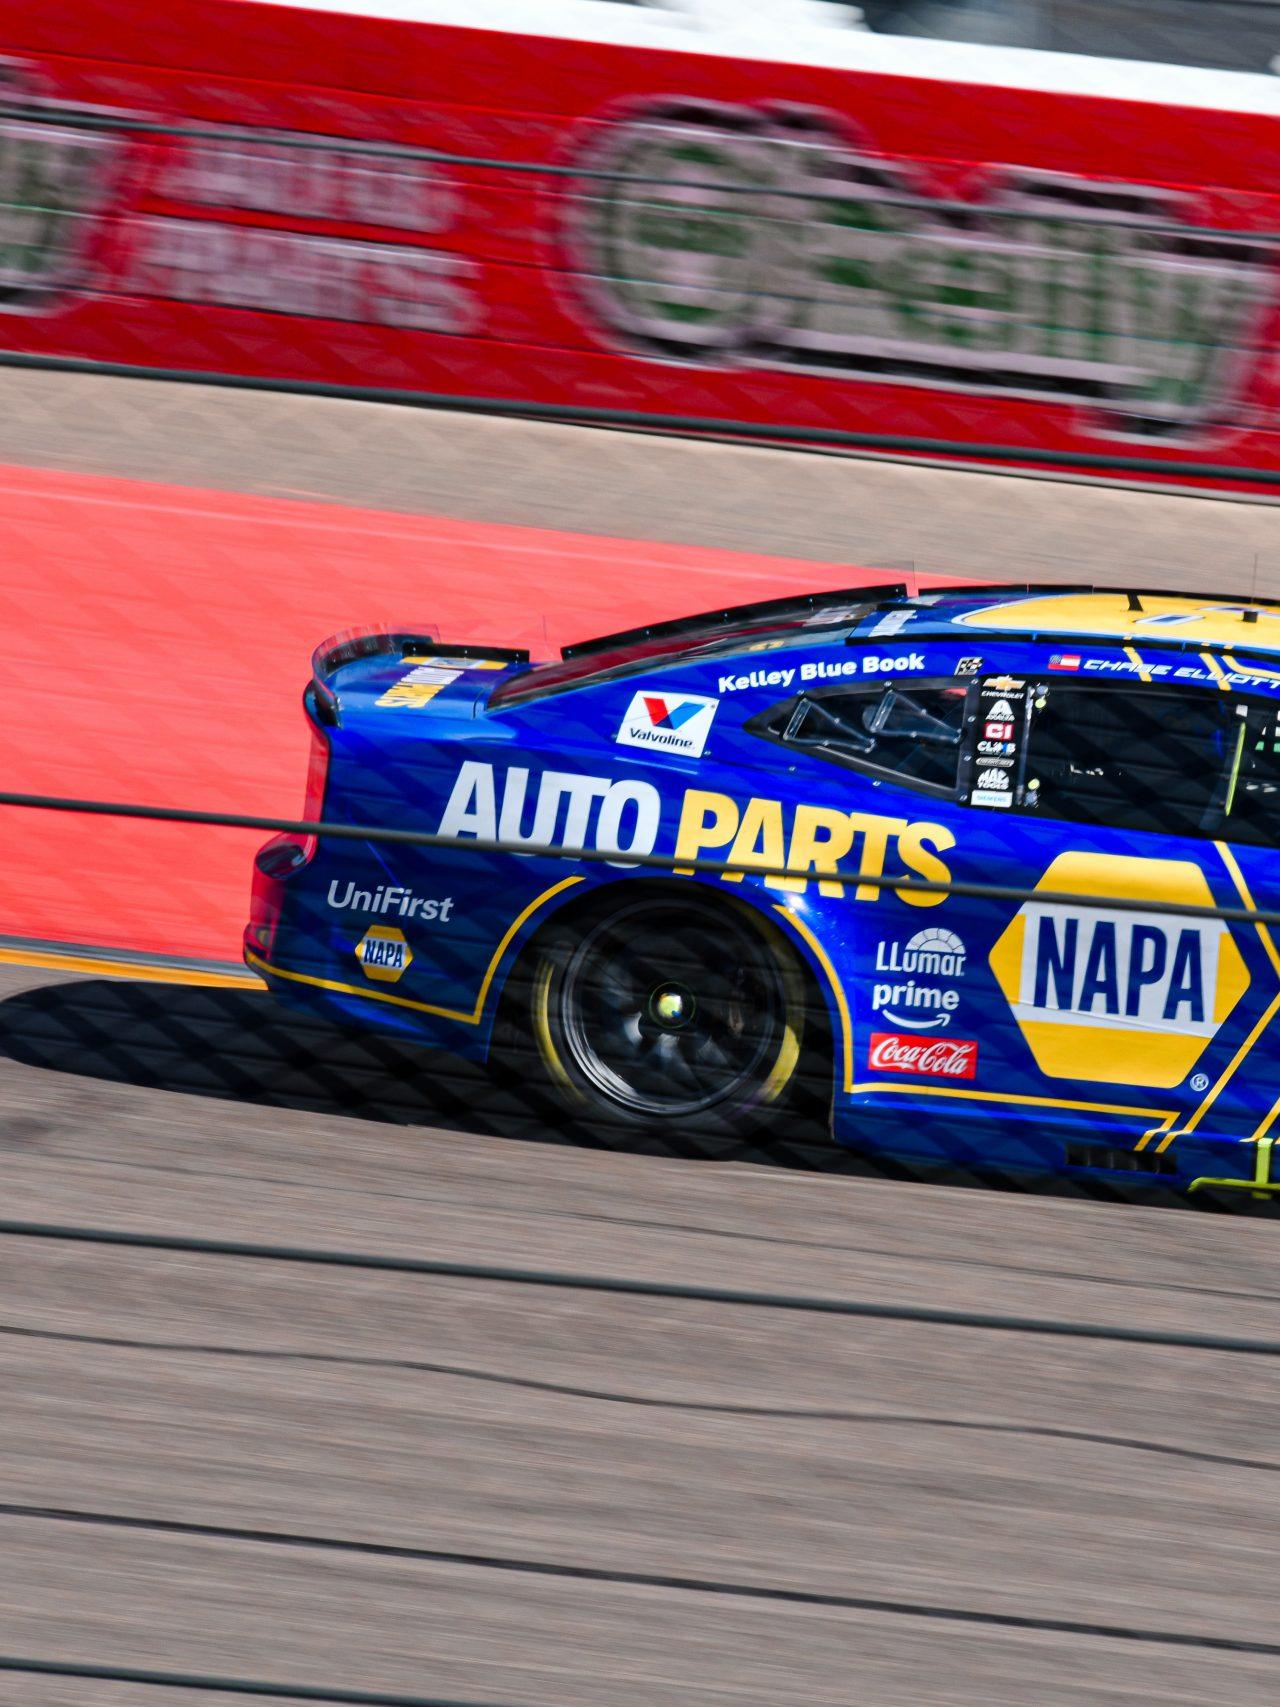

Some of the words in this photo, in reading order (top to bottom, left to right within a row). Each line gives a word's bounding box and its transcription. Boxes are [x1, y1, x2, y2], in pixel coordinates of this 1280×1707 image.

[718, 667, 796, 693] Kelley
[801, 661, 857, 681] Blue
[863, 652, 925, 673] Book
[1083, 659, 1173, 675] CHASE
[629, 727, 694, 748] Valvoline
[436, 760, 662, 868] AUTO
[673, 789, 956, 908] PARTS
[327, 880, 455, 922] UniFirst
[363, 940, 403, 968] NAPA
[876, 940, 966, 976] LLumar
[1033, 915, 1206, 1023] NAPA
[872, 980, 960, 1010] prime
[871, 1037, 975, 1075] Coca-Cola
